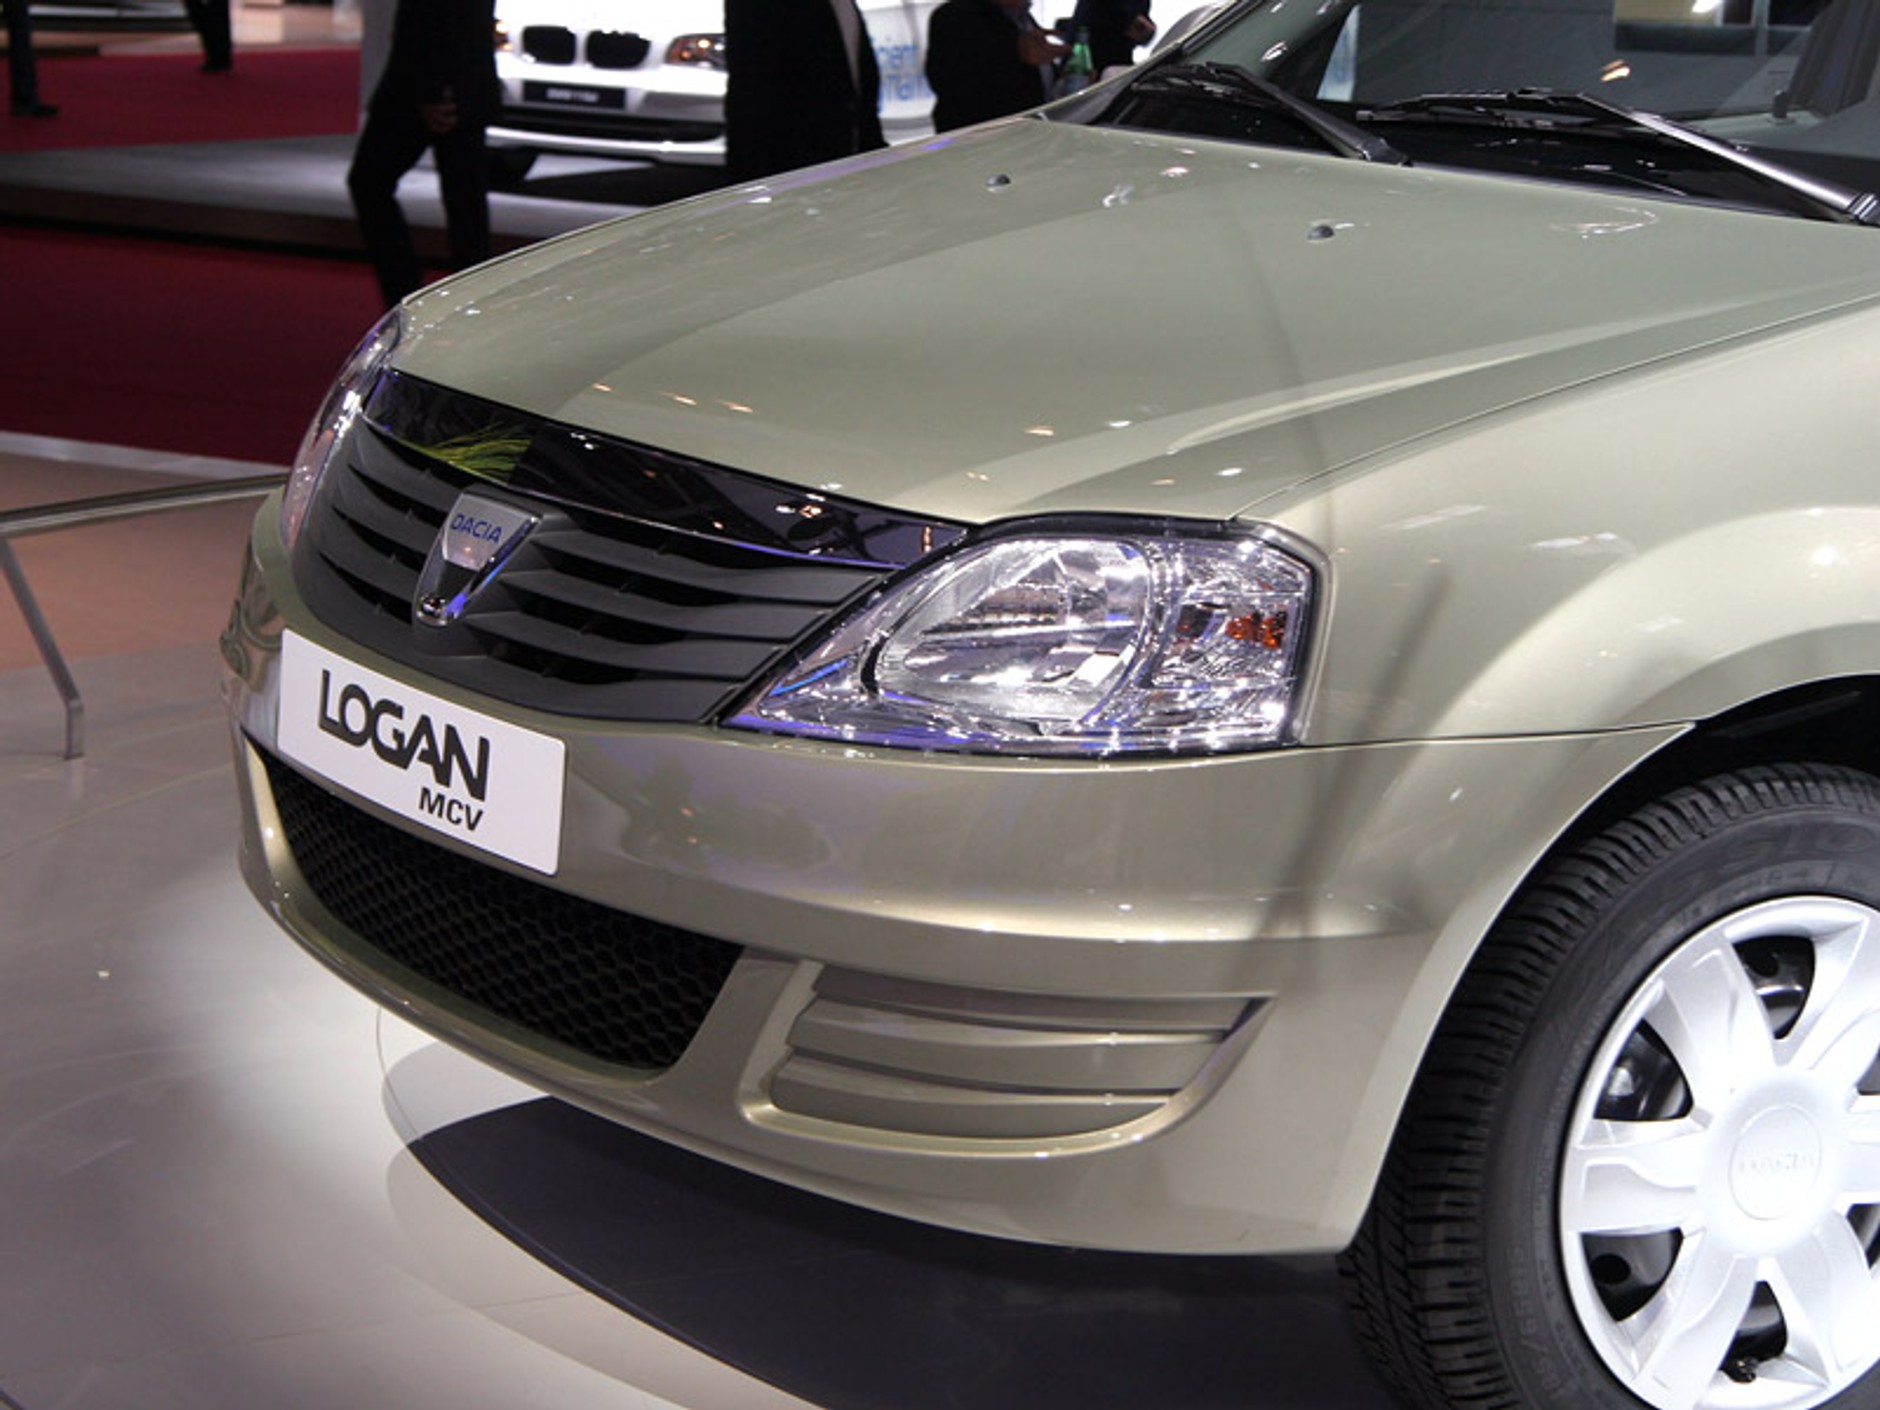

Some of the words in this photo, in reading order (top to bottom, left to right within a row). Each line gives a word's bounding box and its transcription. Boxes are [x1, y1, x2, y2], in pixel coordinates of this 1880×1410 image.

[450, 513, 503, 543] DACIA
[318, 669, 490, 802] LOGAN
[418, 787, 484, 831] MCV
